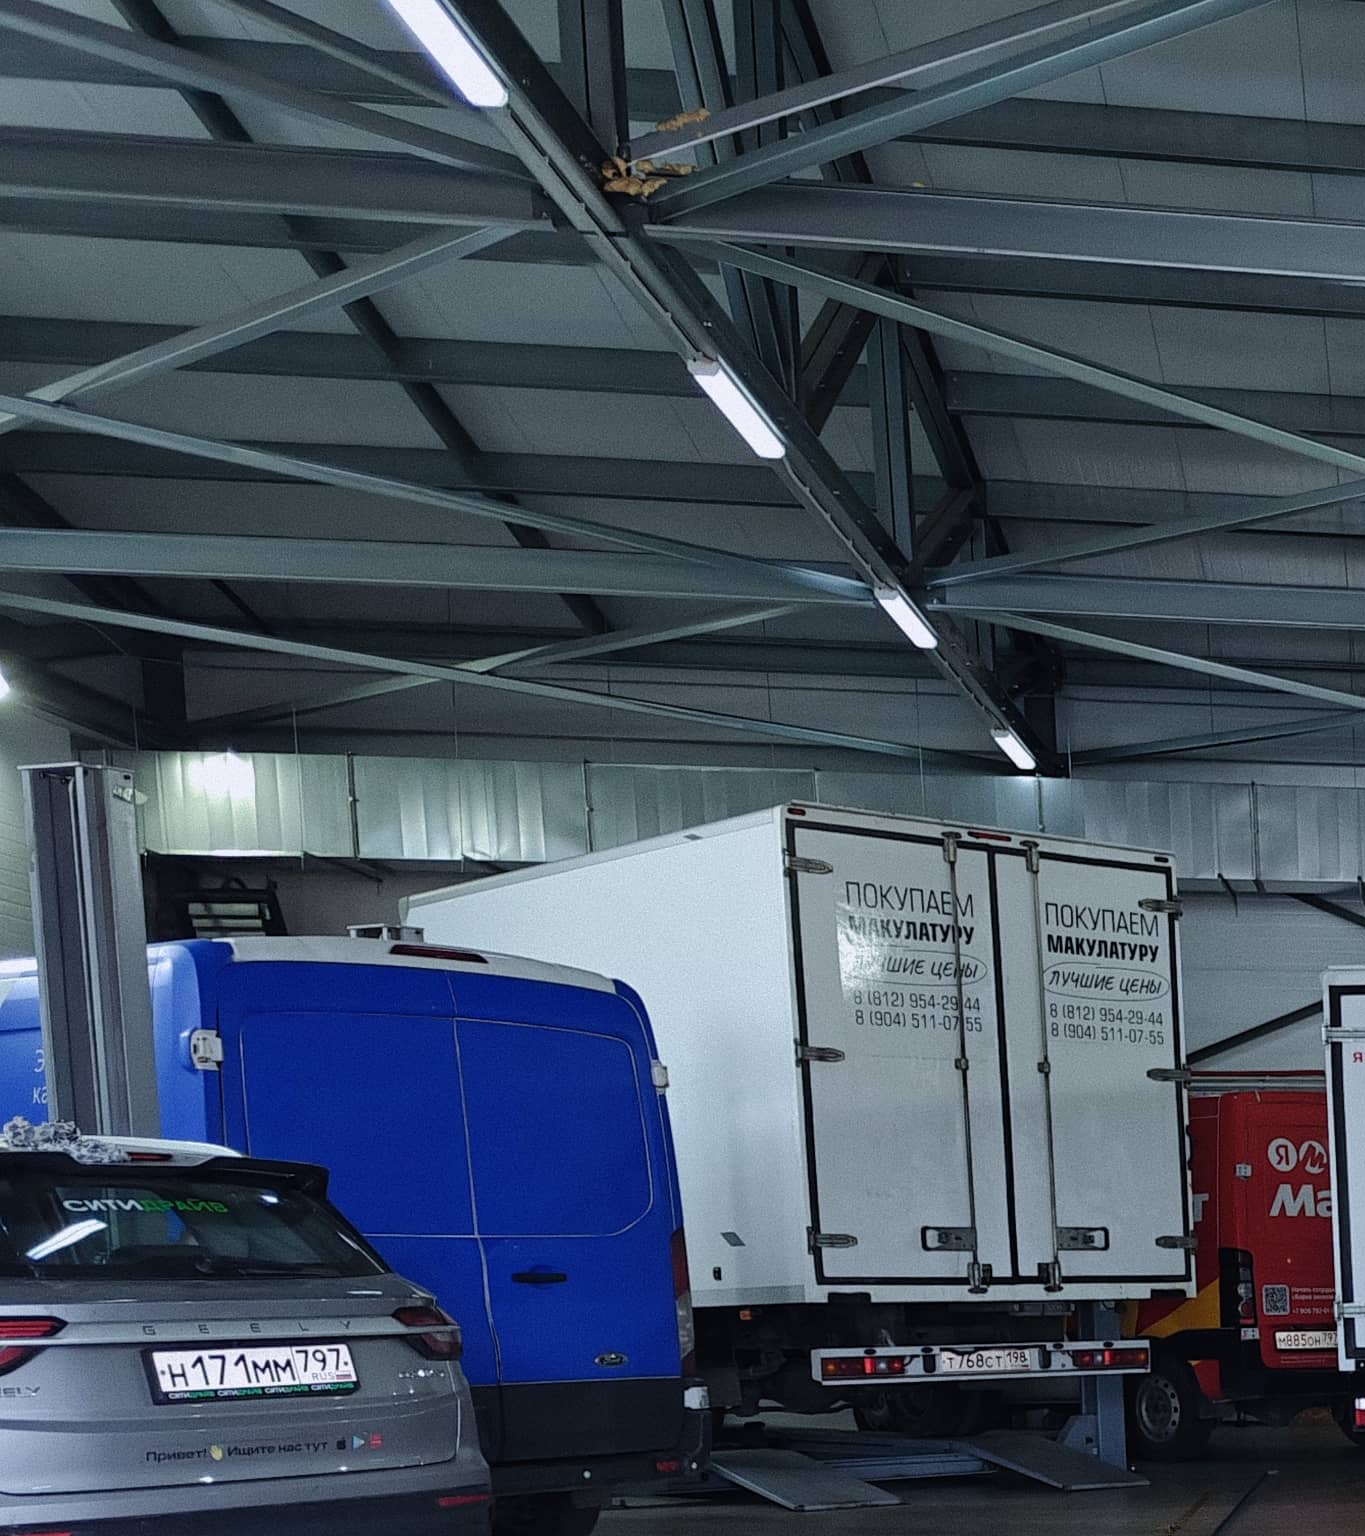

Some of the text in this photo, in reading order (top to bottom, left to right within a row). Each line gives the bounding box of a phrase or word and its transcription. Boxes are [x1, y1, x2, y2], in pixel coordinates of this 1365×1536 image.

[846, 880, 974, 918] ПОКУПАЕМ
[1044, 901, 1160, 937] ПОКУПАЕМ
[1047, 933, 1160, 963] МАКУЛАТУРУ
[1049, 970, 1163, 996] ЛУЧШИЕ ЦЕНЫ
[867, 990, 905, 1007] (812)
[855, 1011, 864, 1026] 8
[869, 1011, 907, 1029] (904)
[1050, 1003, 1164, 1026] 8 (812) 954-29-44
[1051, 1022, 1165, 1046] 8 (904) 511-07-55
[1352, 1051, 1363, 1063] Я
[142, 1320, 351, 1336] GEELY
[167, 1348, 341, 1388] Н171ММ 797
[312, 1371, 336, 1381] RUS
[145, 1441, 328, 1463] Привет! Ищите нас тут
